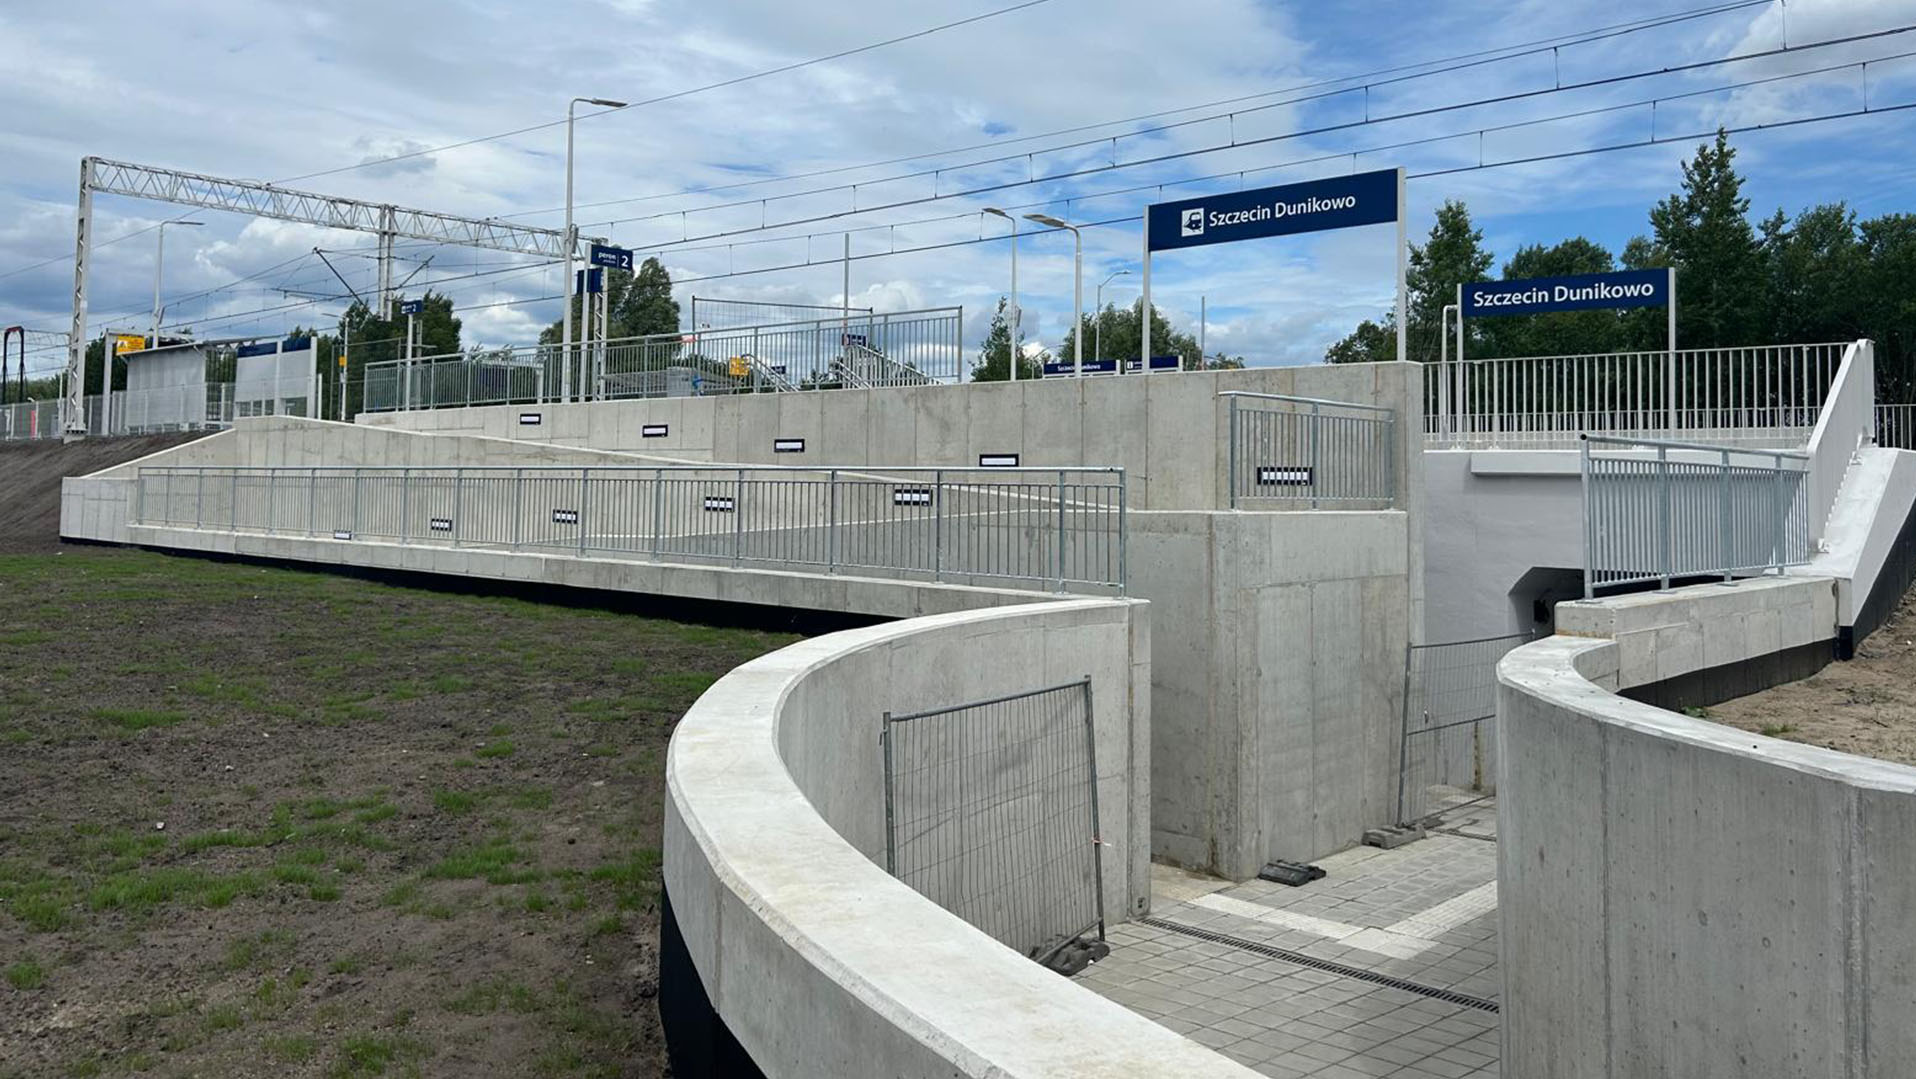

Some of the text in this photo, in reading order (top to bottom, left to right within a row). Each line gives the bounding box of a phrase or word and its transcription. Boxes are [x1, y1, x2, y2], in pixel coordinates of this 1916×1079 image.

[1209, 196, 1357, 227] Szczecin Dunikowo
[621, 255, 629, 267] 2
[1473, 282, 1654, 307] Szczecin Dunikowo
